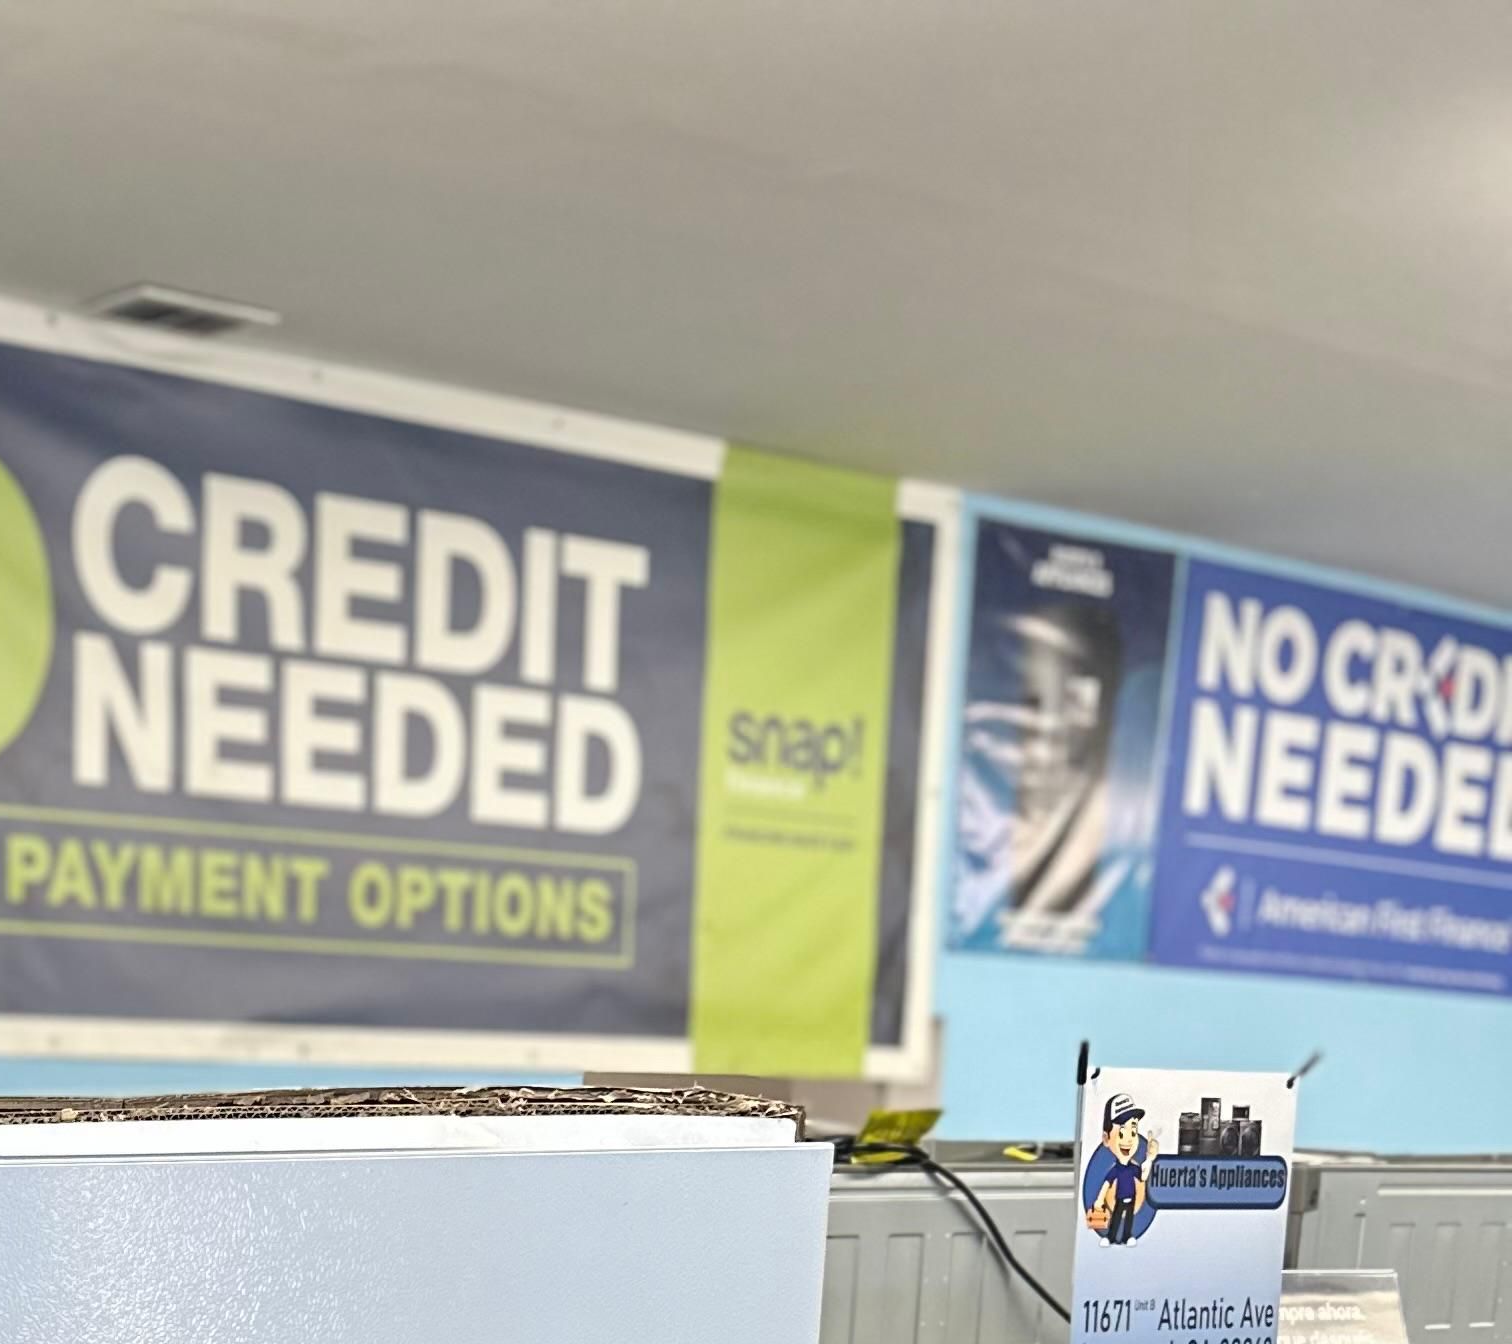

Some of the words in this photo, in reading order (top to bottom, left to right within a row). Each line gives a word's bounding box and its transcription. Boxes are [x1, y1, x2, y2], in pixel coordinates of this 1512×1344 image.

[72, 455, 649, 692] CREDIT
[1197, 590, 1319, 706] NO
[72, 634, 643, 836] NEEDED
[5, 828, 330, 926] PAYMENT
[348, 861, 614, 945] OPTIONS
[1150, 1163, 1206, 1188] Huerta's
[1209, 1163, 1285, 1191] Appliances
[1083, 1299, 1131, 1333] 11671
[1157, 1297, 1235, 1331] Atlantic
[1240, 1296, 1275, 1329] Ave
